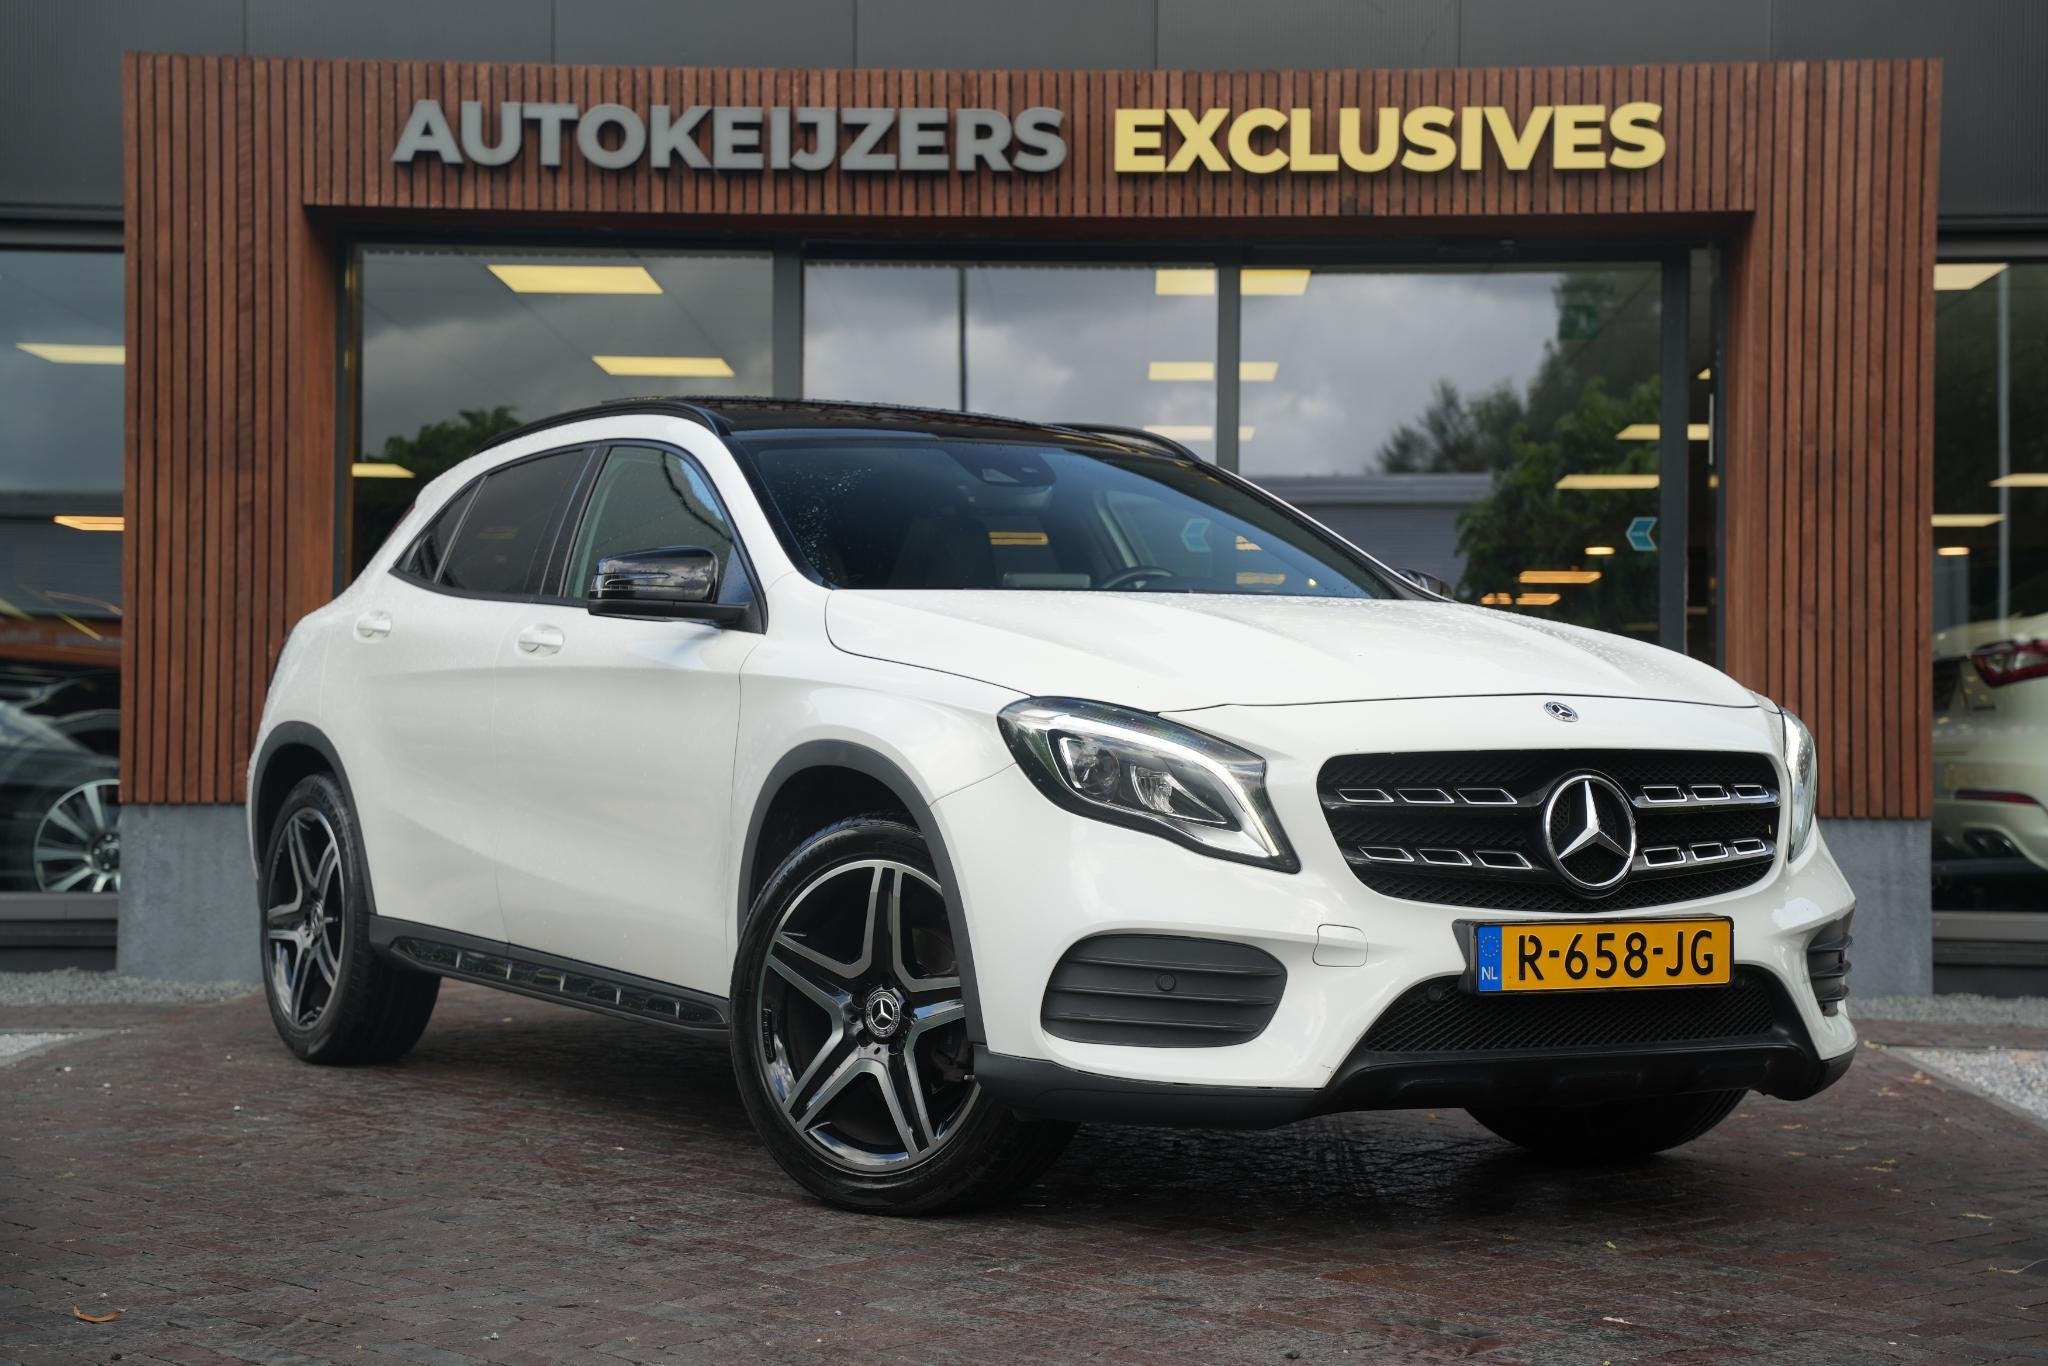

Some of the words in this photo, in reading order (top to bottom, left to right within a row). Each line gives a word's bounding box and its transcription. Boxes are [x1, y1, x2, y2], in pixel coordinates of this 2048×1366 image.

[391, 100, 1068, 174] AUTOKEIJZERS
[1114, 102, 1667, 174] EXCLUSIVES
[1481, 966, 1498, 981] NL
[1518, 930, 1714, 981] R-658-JG
